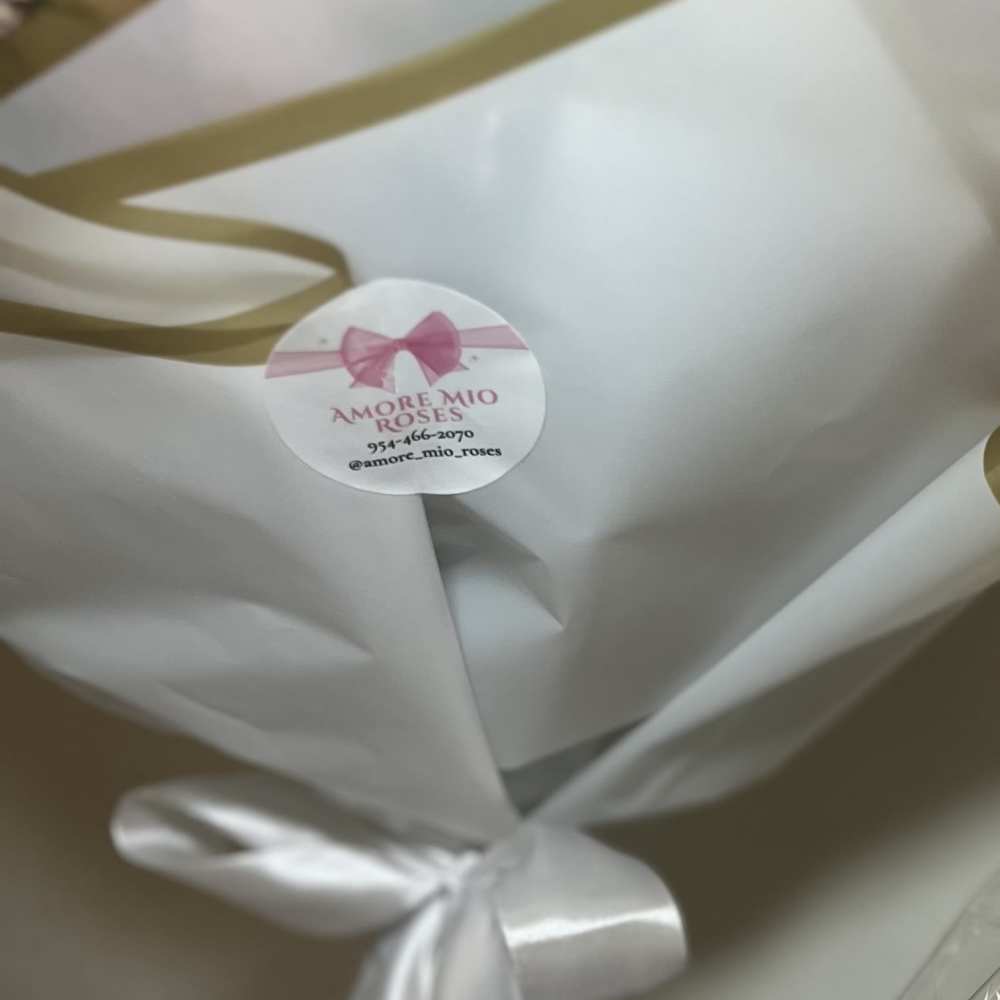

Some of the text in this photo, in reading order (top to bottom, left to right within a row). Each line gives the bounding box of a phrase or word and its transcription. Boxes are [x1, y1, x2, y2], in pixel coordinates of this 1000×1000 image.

[330, 389, 498, 424] AMORE MIO
[376, 407, 464, 433] ROSES
[367, 428, 474, 454] 954-466-2070
[348, 446, 503, 471] @amore_mio_roses
